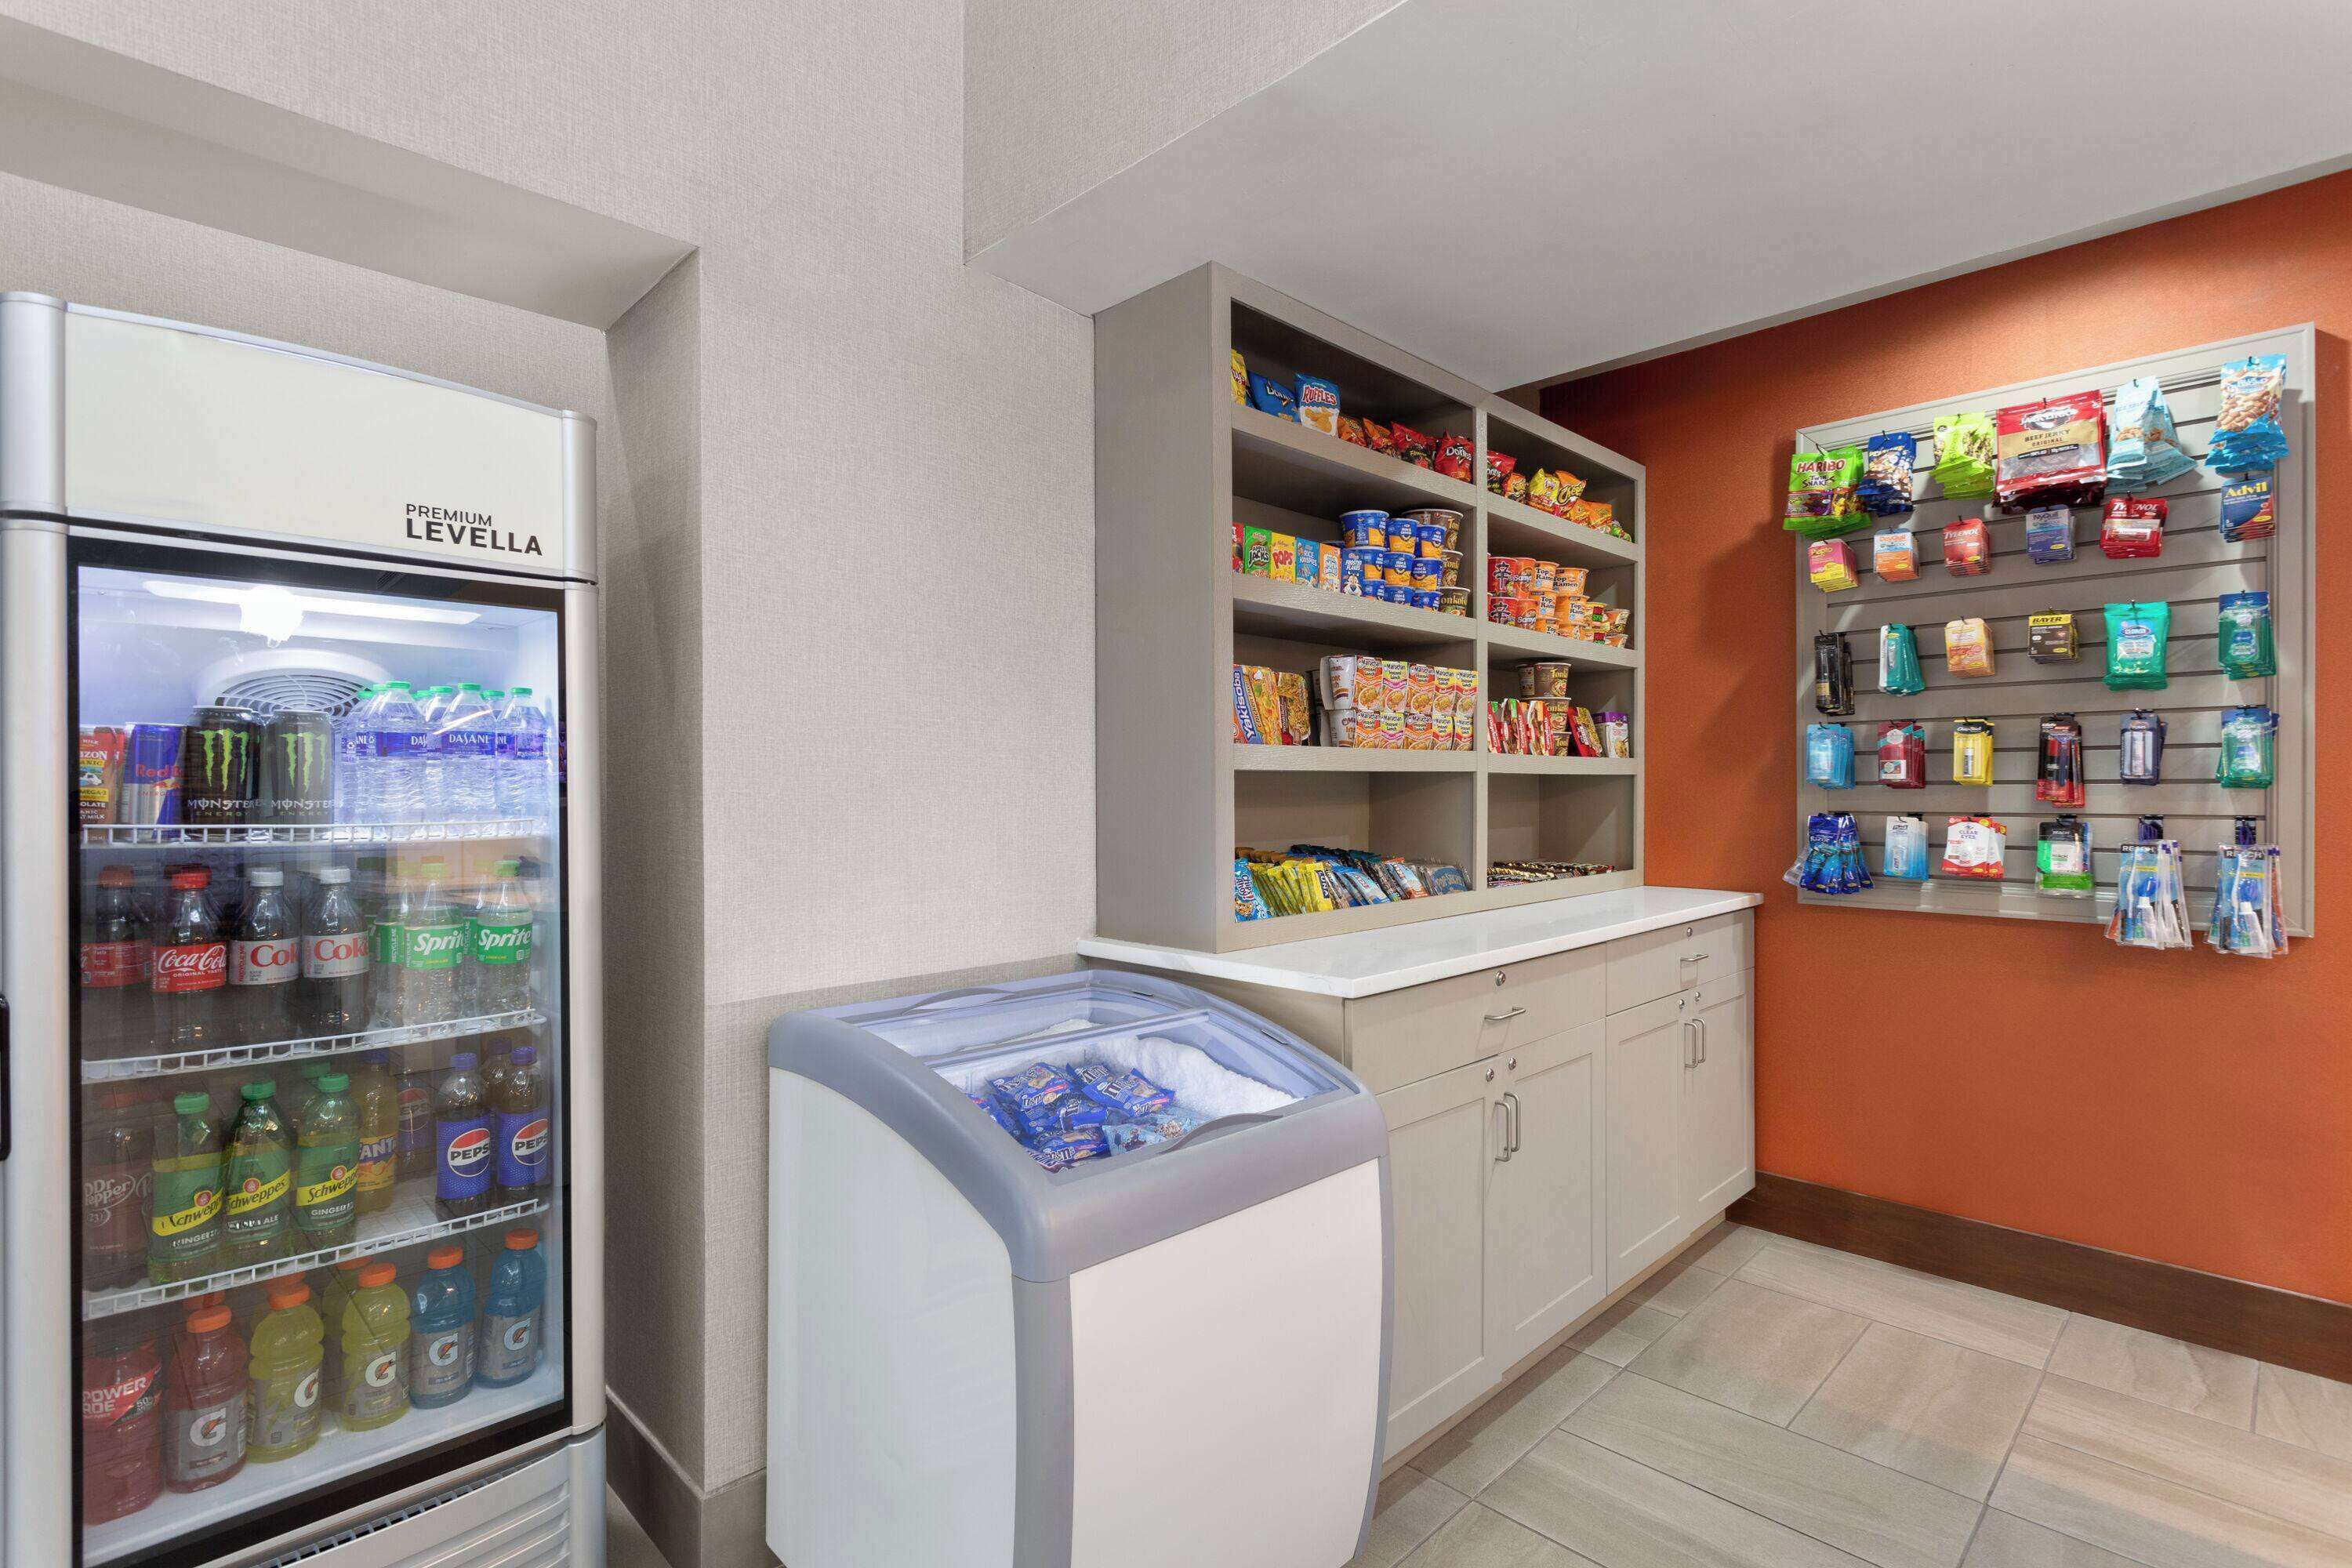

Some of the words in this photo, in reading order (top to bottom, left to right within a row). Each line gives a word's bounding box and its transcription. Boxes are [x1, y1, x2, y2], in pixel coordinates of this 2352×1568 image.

[1302, 385, 1338, 405] RUFFLES
[2024, 433, 2043, 441] BEEF
[2044, 429, 2071, 439] JERKY
[2032, 437, 2063, 447] ORIGINAL
[1796, 458, 1846, 474] HARIBO
[2223, 481, 2268, 498] Advil
[406, 503, 492, 526] PREMIUM
[406, 517, 543, 556] LEVELLA
[1944, 528, 1980, 539] TYLENOL
[1248, 550, 1269, 568] JACKS
[1272, 550, 1293, 569] POPS
[1234, 671, 1256, 740] Yakisoba
[448, 733, 490, 745] DASANI
[80, 750, 107, 760] IZON
[135, 764, 169, 779] Red
[478, 928, 532, 952] Sprite
